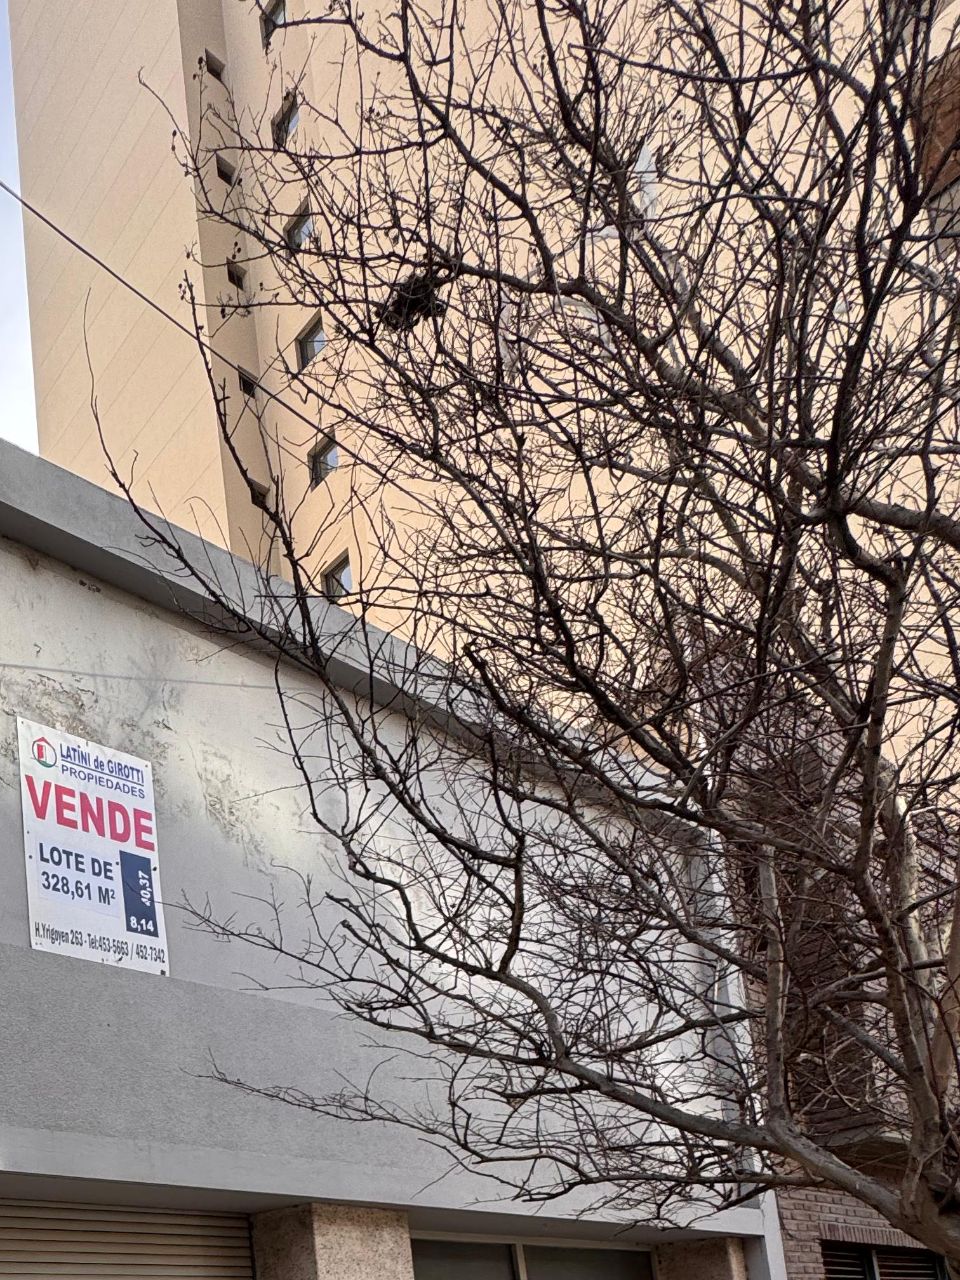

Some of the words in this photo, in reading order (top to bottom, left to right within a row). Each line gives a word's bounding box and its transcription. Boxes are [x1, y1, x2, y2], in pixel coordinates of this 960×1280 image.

[60, 743, 91, 767] LATINI
[94, 755, 105, 771] de
[107, 760, 145, 783] GIROTTI
[61, 765, 145, 799] PROPIEDADES
[25, 774, 155, 852] VENDE
[39, 843, 85, 873] LOTE
[91, 857, 114, 881] DE
[41, 871, 92, 900] 328,61
[138, 870, 152, 906] 40,37
[130, 916, 154, 932] 8,14
[70, 929, 83, 946] 263
[135, 943, 166, 963] 452-7342
